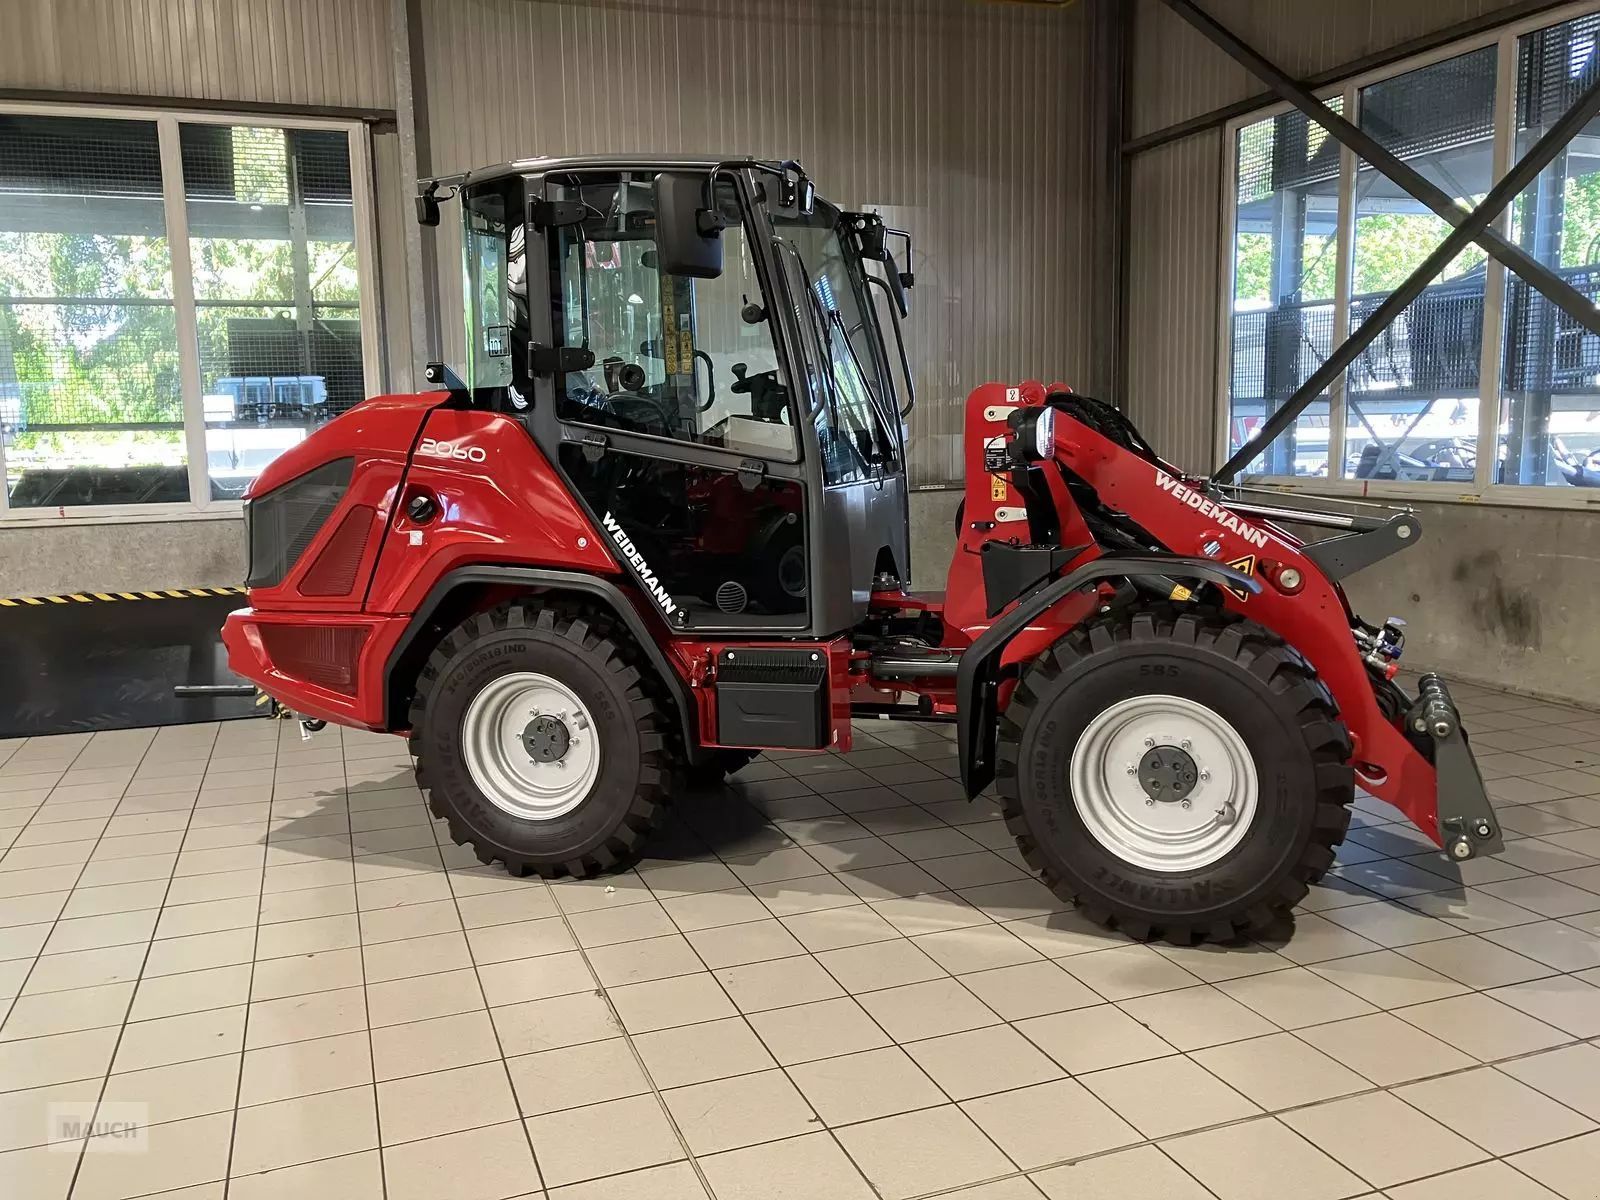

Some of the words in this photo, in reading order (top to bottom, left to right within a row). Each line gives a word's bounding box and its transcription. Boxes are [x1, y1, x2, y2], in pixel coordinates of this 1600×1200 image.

[419, 437, 487, 463] 2060
[1154, 469, 1270, 549] WEIDEMANN
[602, 510, 677, 616] WEIDEMANN
[1138, 664, 1180, 679] 585
